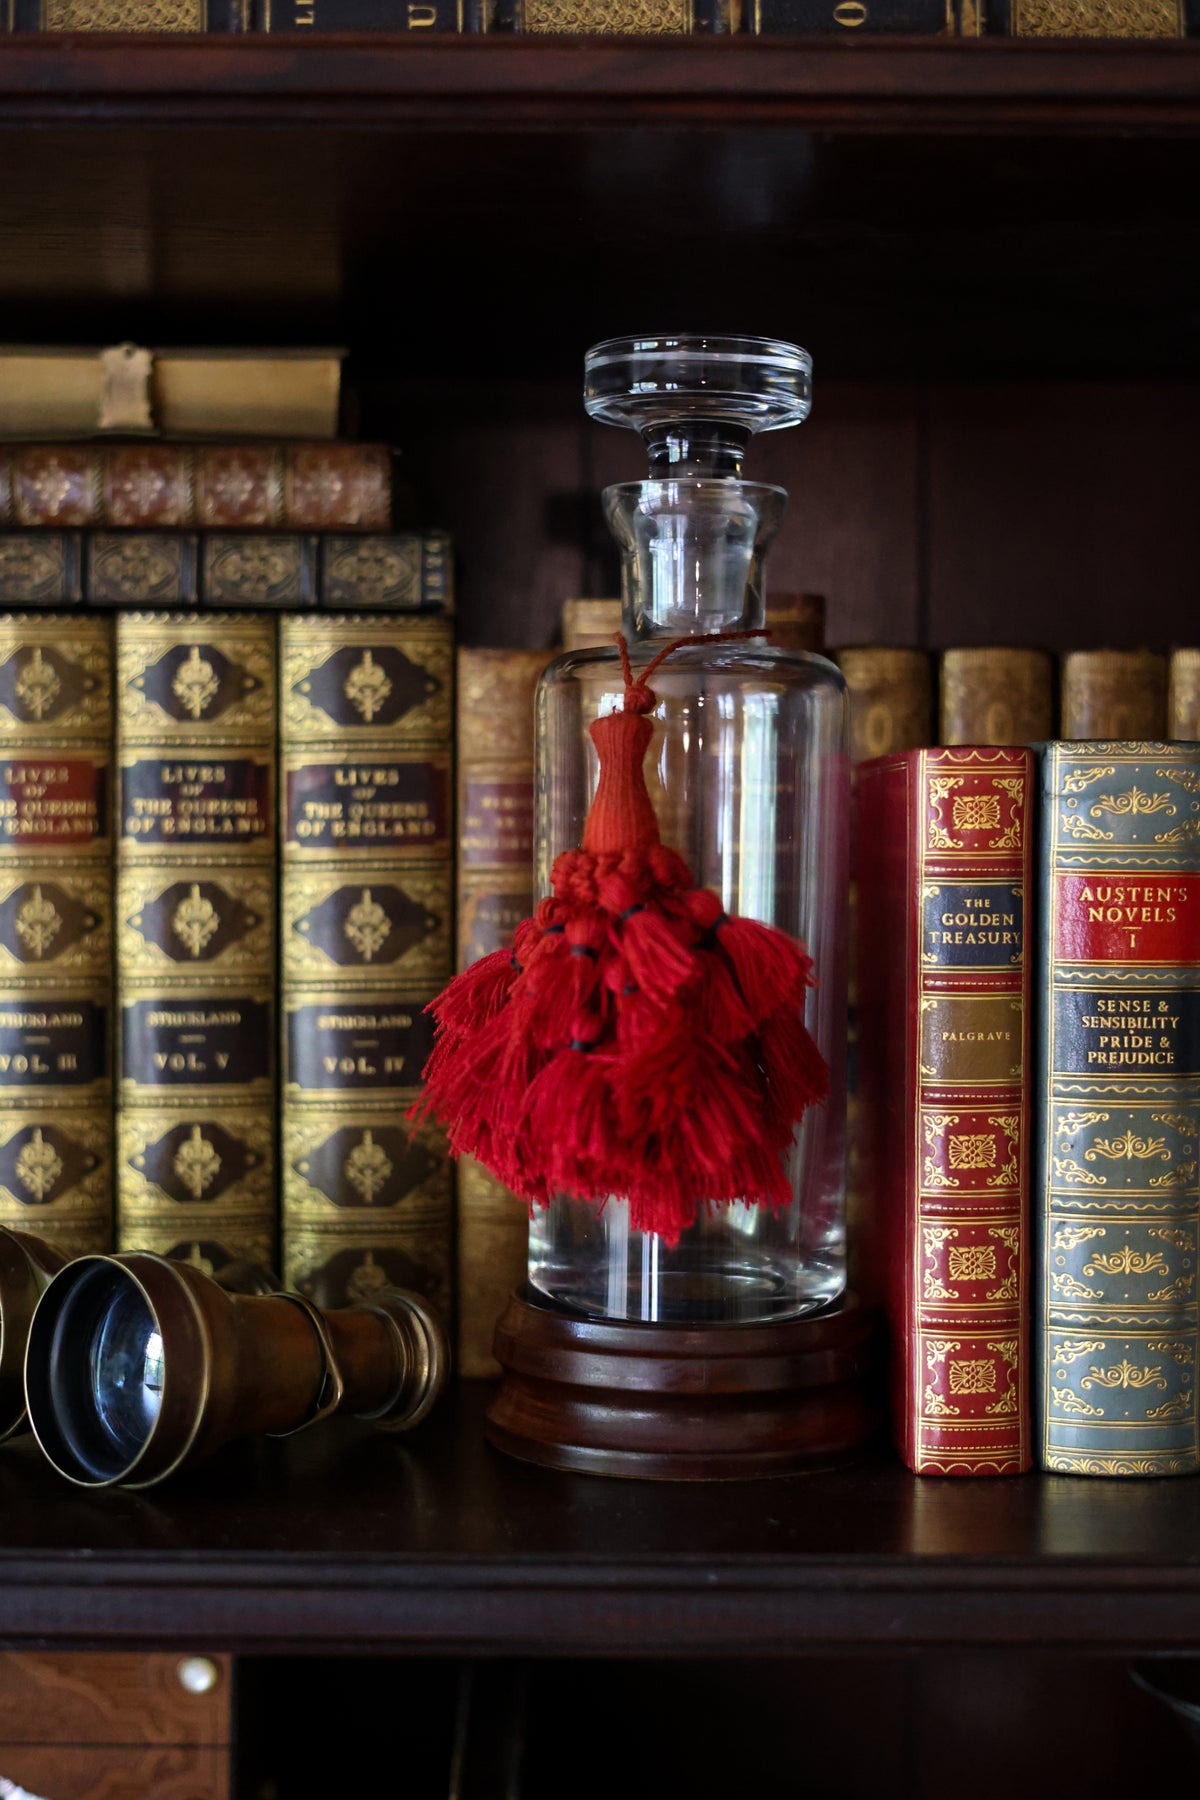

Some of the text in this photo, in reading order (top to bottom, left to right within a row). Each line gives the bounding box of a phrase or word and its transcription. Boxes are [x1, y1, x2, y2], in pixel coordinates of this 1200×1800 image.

[4, 767, 69, 784] LIVES
[161, 766, 226, 784] LIVES
[334, 769, 400, 786] LIVES
[22, 783, 47, 797] OF
[178, 783, 204, 797] OF
[351, 786, 377, 800] OF
[20, 800, 97, 820] QUEENS
[131, 798, 258, 820] THE QUEENS
[303, 801, 429, 823] THE QUEENS
[4, 818, 99, 836] ENGLAND
[125, 816, 266, 834] OF ENGLAND
[296, 819, 436, 838] OF ENGLAND
[1079, 886, 1187, 903] AUSTEN'S
[963, 898, 991, 908] THE
[941, 913, 1014, 927] GOLDEN
[1088, 906, 1176, 923] NOVELS
[928, 931, 1021, 945] TREASURY
[1096, 1000, 1170, 1013] SENSE &
[0, 1012, 83, 1028] TRICKLAND
[145, 1011, 242, 1027] STRICKLAND
[1081, 1016, 1180, 1029] SENSIBILITY
[942, 1031, 1012, 1041] PALGRAVE
[1099, 1035, 1171, 1049] PRIDE &
[214, 1051, 230, 1071] V
[384, 1056, 405, 1073] IV
[1087, 1051, 1175, 1065] PREJUDICE
